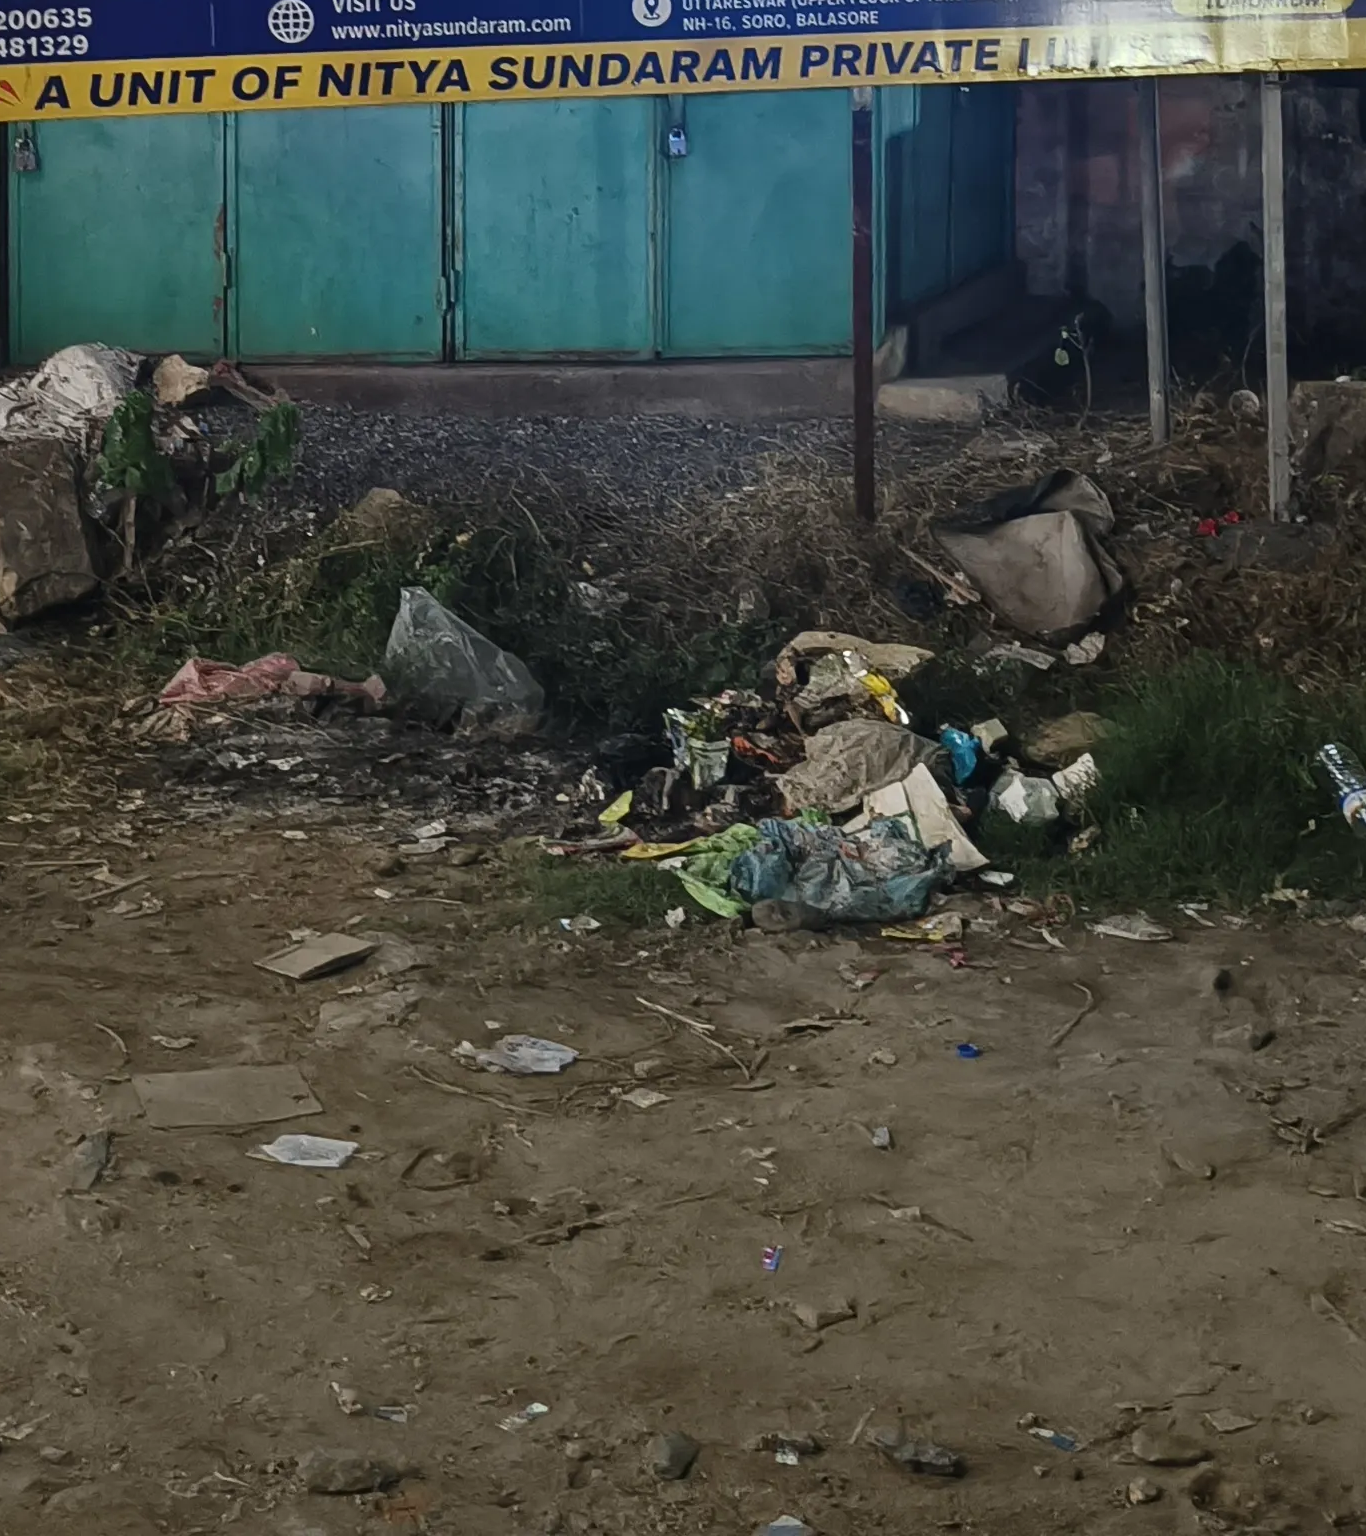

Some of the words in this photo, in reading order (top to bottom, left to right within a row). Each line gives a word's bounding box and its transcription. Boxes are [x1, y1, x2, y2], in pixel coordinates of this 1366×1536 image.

[331, 15, 572, 41] www.nityasundaram.com
[683, 16, 737, 32] NH-16,
[741, 13, 791, 31] SORO,
[795, 10, 879, 27] BALASORE
[34, 74, 71, 110] A
[89, 68, 217, 107] UNIT
[231, 65, 302, 101] OF
[318, 58, 472, 98] NITYA
[488, 46, 783, 90] SUNDARAM
[799, 38, 1001, 78] PRIVATE
